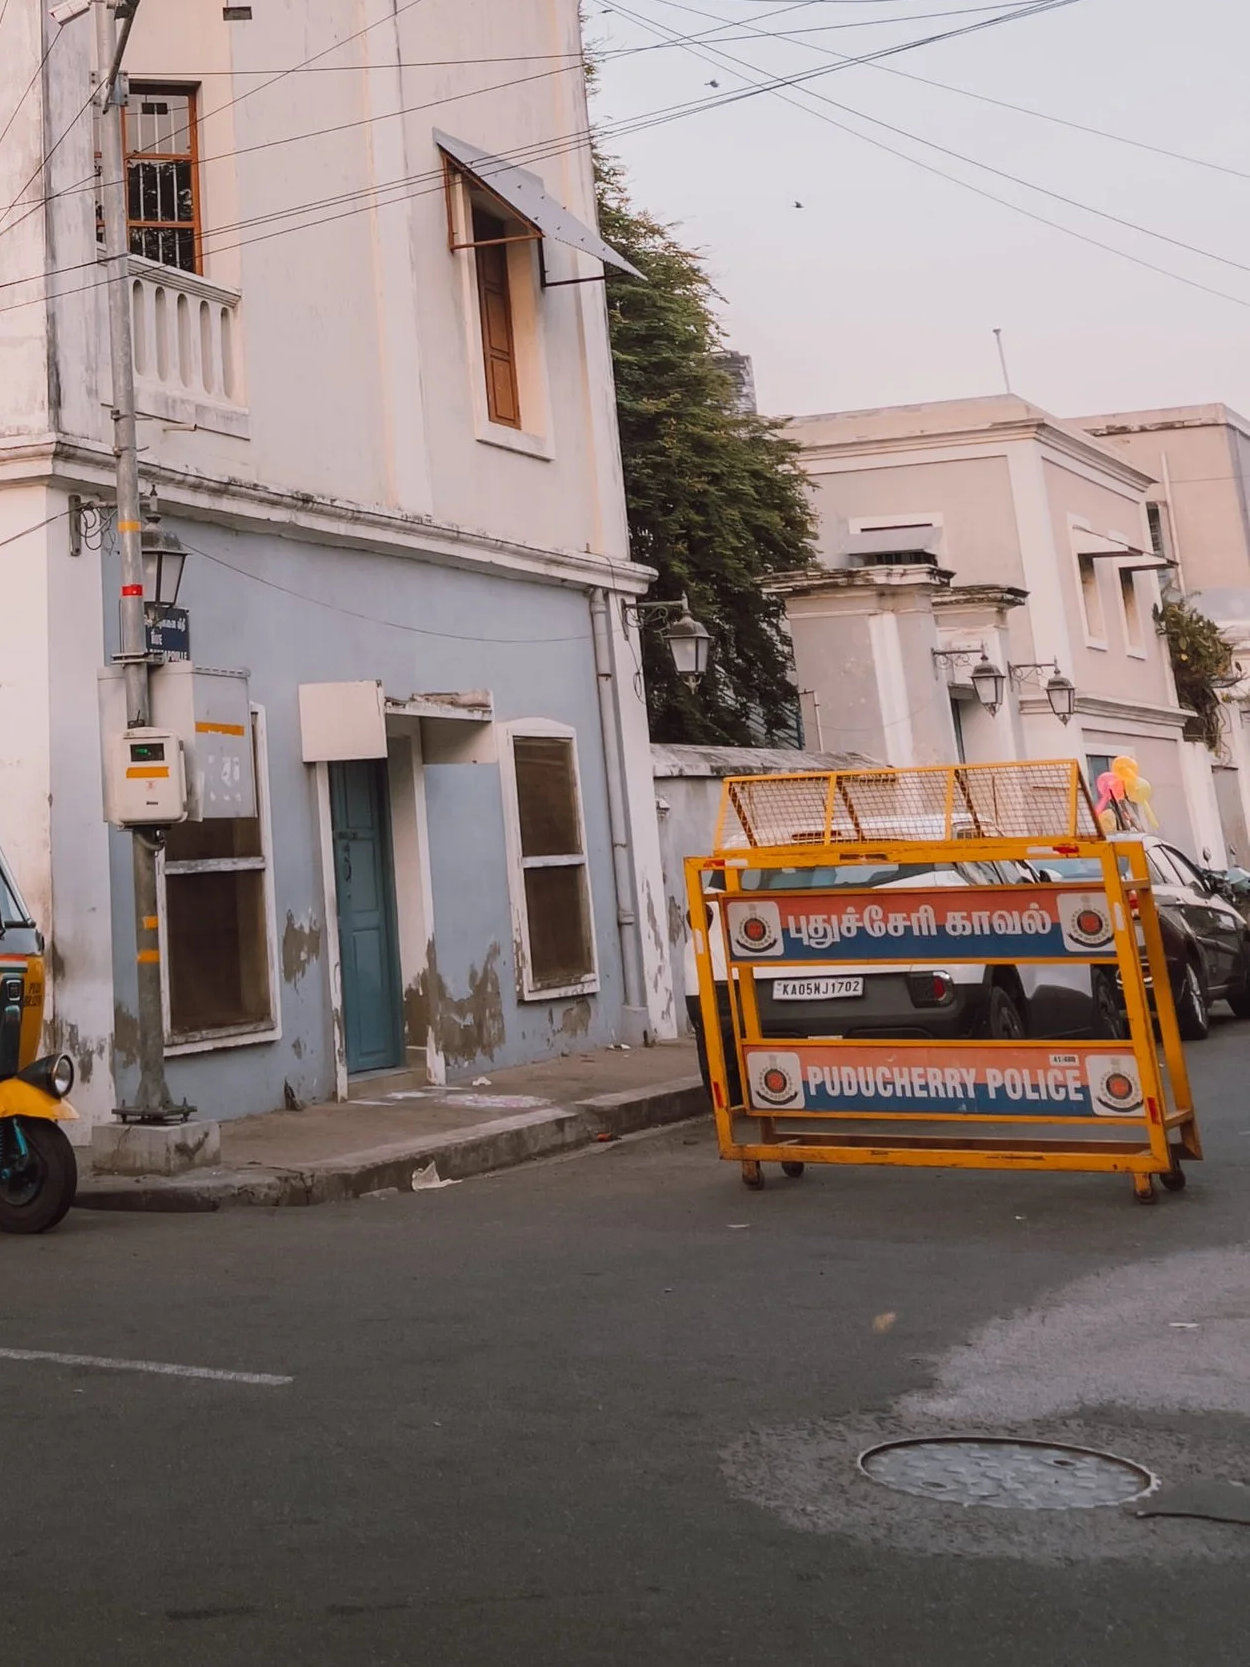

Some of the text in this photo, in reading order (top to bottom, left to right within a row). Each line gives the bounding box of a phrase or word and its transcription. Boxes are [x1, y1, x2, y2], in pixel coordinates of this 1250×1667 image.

[788, 902, 1052, 948] புதுச்சேரி காவல்
[806, 1066, 1085, 1101] PUDUCHERRY POLICE
